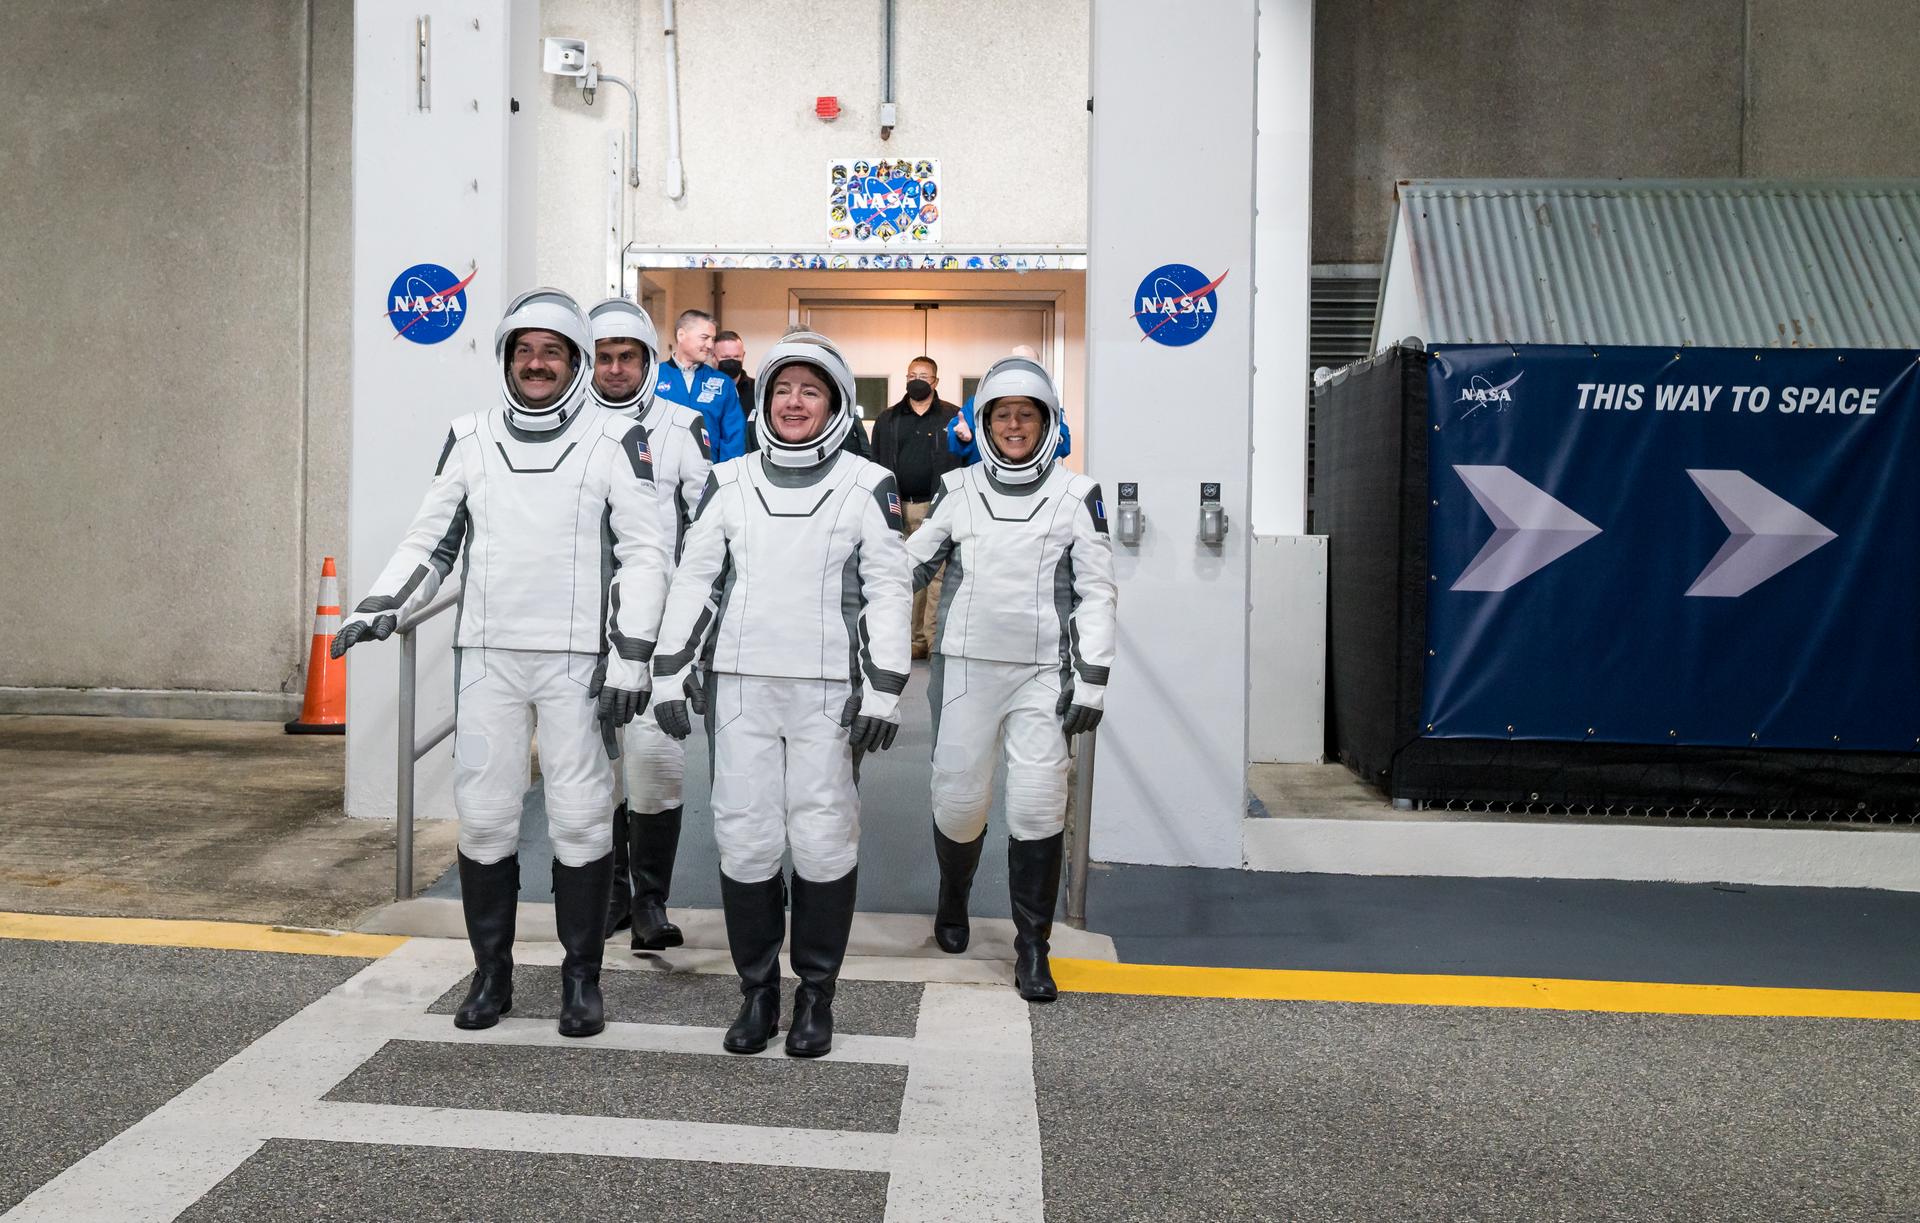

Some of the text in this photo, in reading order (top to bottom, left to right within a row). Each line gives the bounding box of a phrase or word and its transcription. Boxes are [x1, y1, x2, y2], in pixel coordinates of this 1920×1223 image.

[852, 193, 917, 209] NASA
[394, 295, 463, 312] NASA
[1141, 296, 1213, 314] NASA
[1462, 388, 1512, 401] NASA
[1577, 383, 1880, 415] THIS WAY TO SPACE
